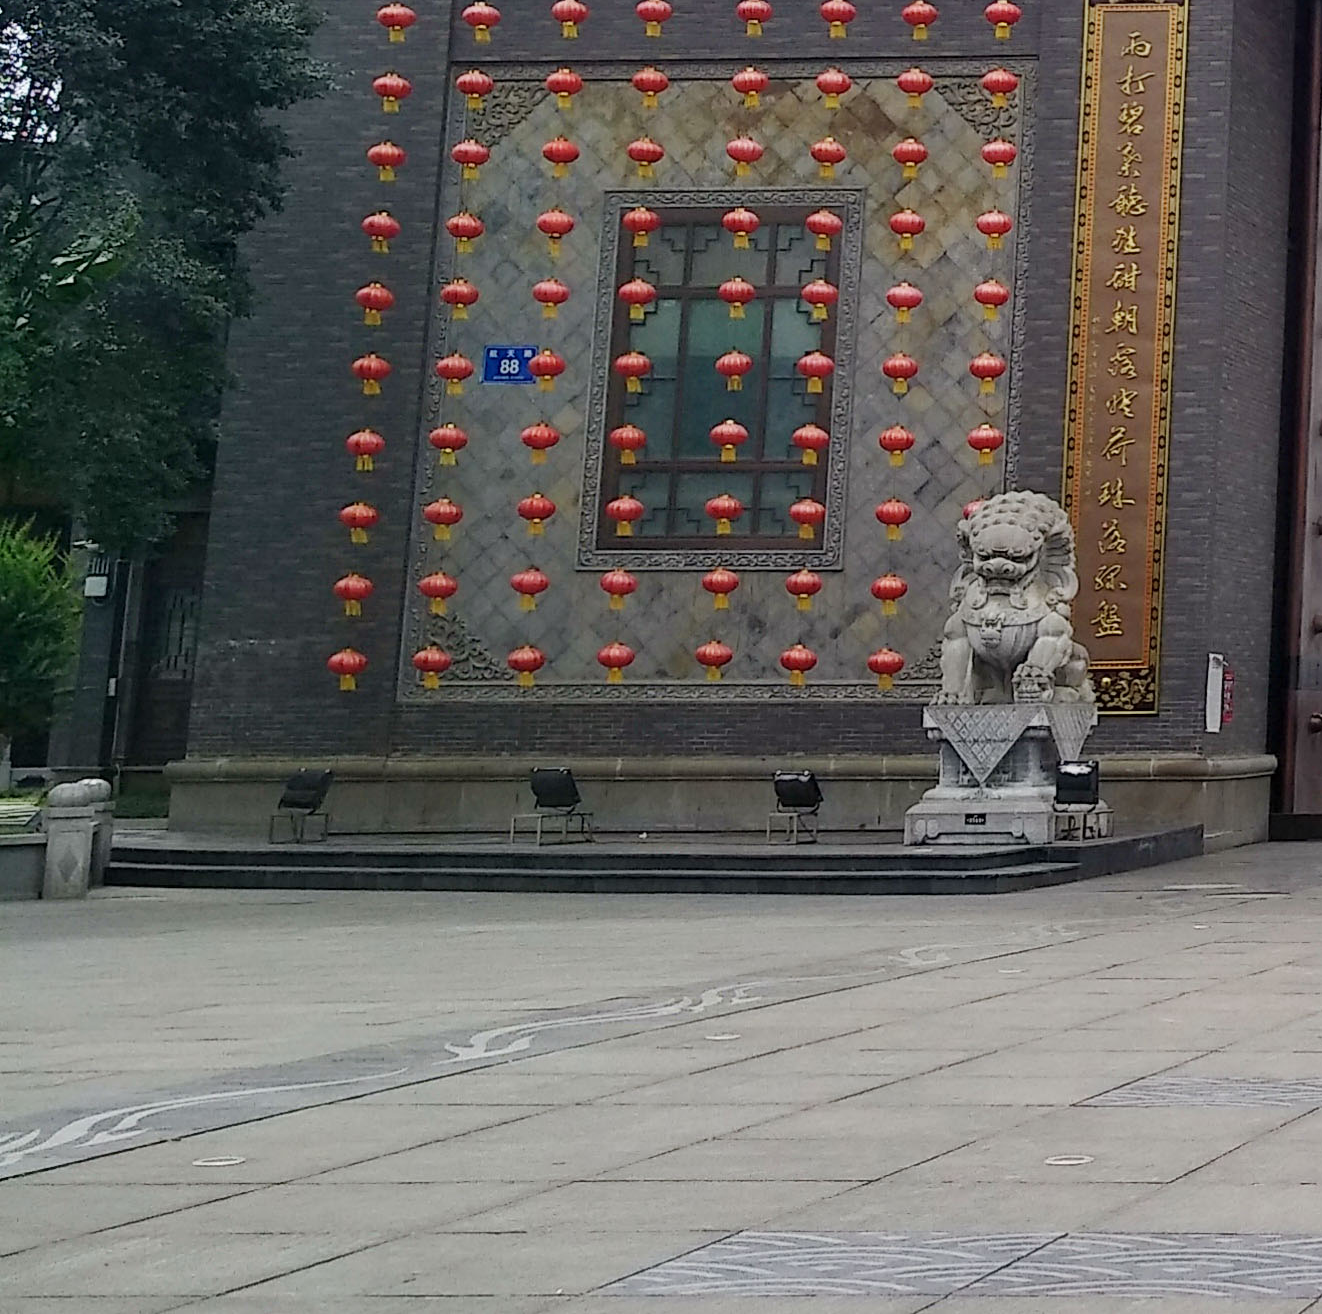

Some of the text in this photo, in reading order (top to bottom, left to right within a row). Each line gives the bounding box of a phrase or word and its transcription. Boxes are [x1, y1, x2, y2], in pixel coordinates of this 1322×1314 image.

[489, 349, 533, 359] 航天路
[500, 359, 519, 374] 88
